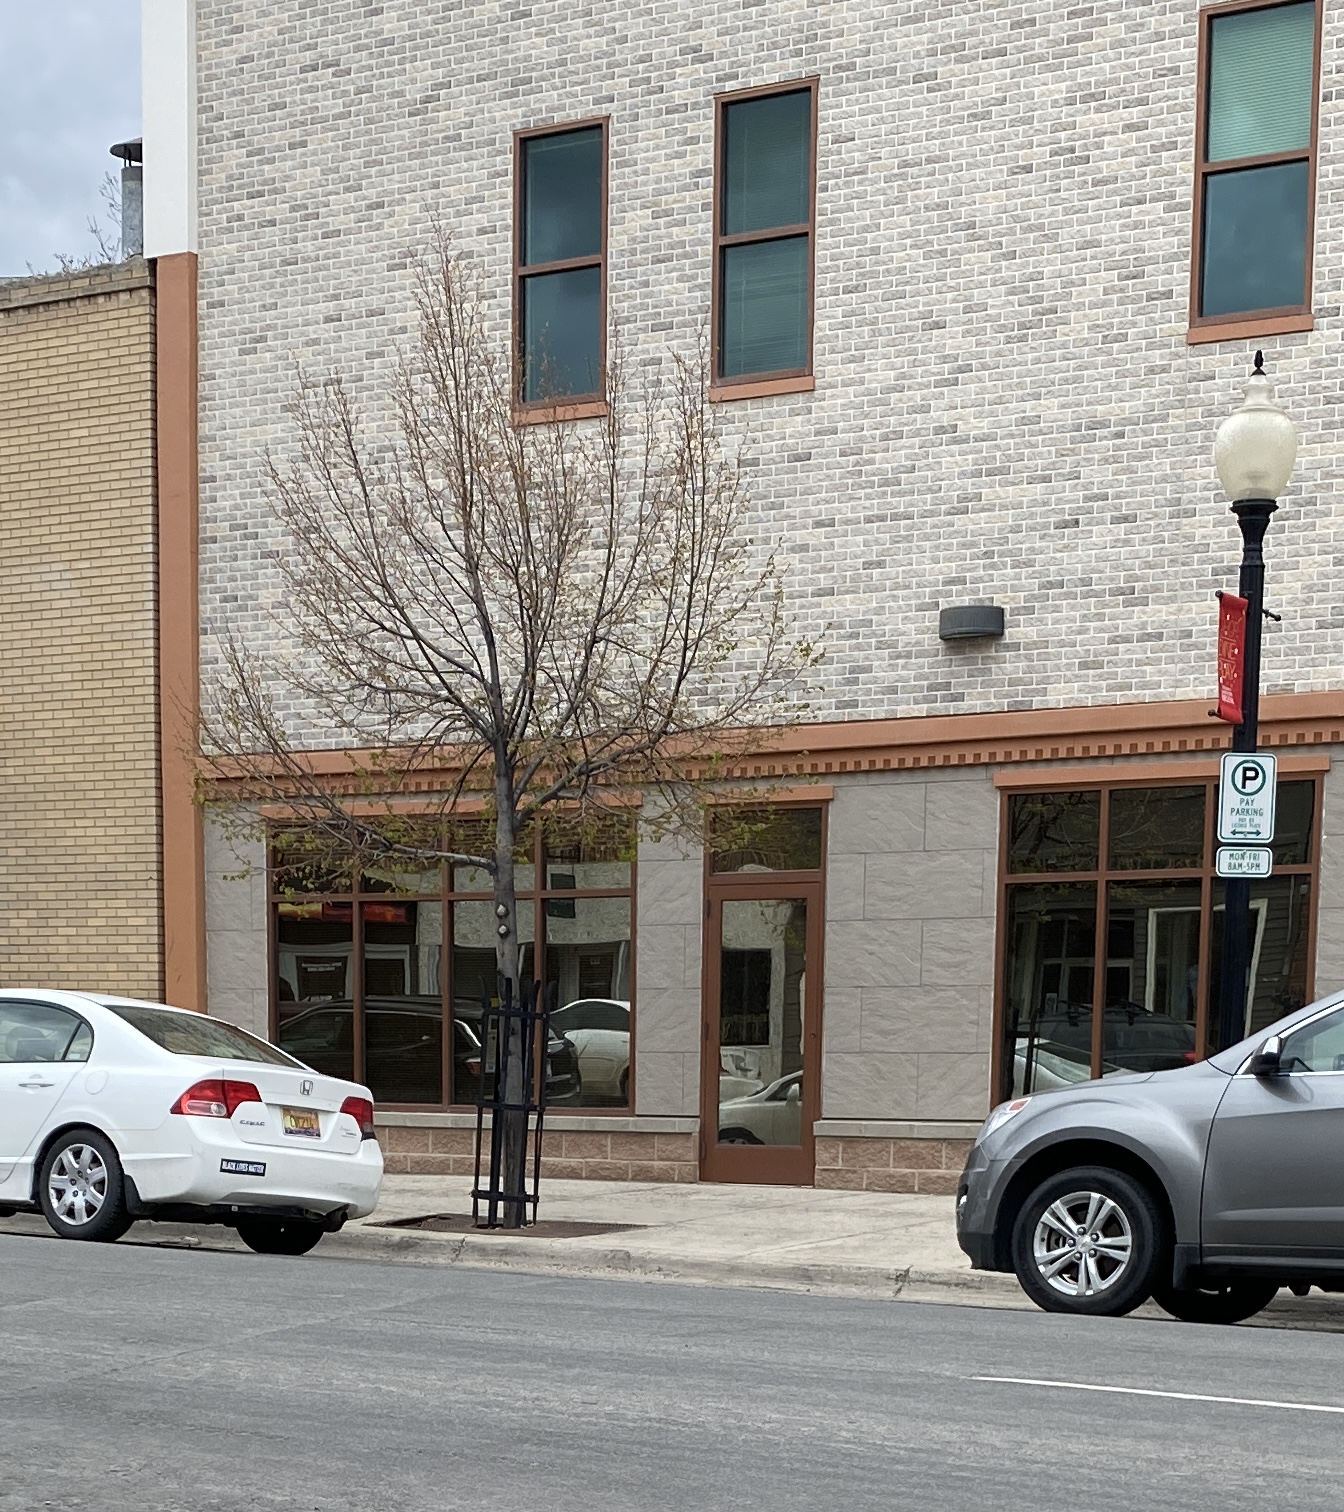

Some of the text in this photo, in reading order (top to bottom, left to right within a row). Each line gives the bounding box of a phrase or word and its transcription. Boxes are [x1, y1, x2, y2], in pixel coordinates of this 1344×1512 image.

[1241, 766, 1260, 789] P
[1239, 798, 1255, 806] PAY
[1230, 807, 1264, 816] PARKING
[1227, 862, 1261, 871] 8AM-5PM
